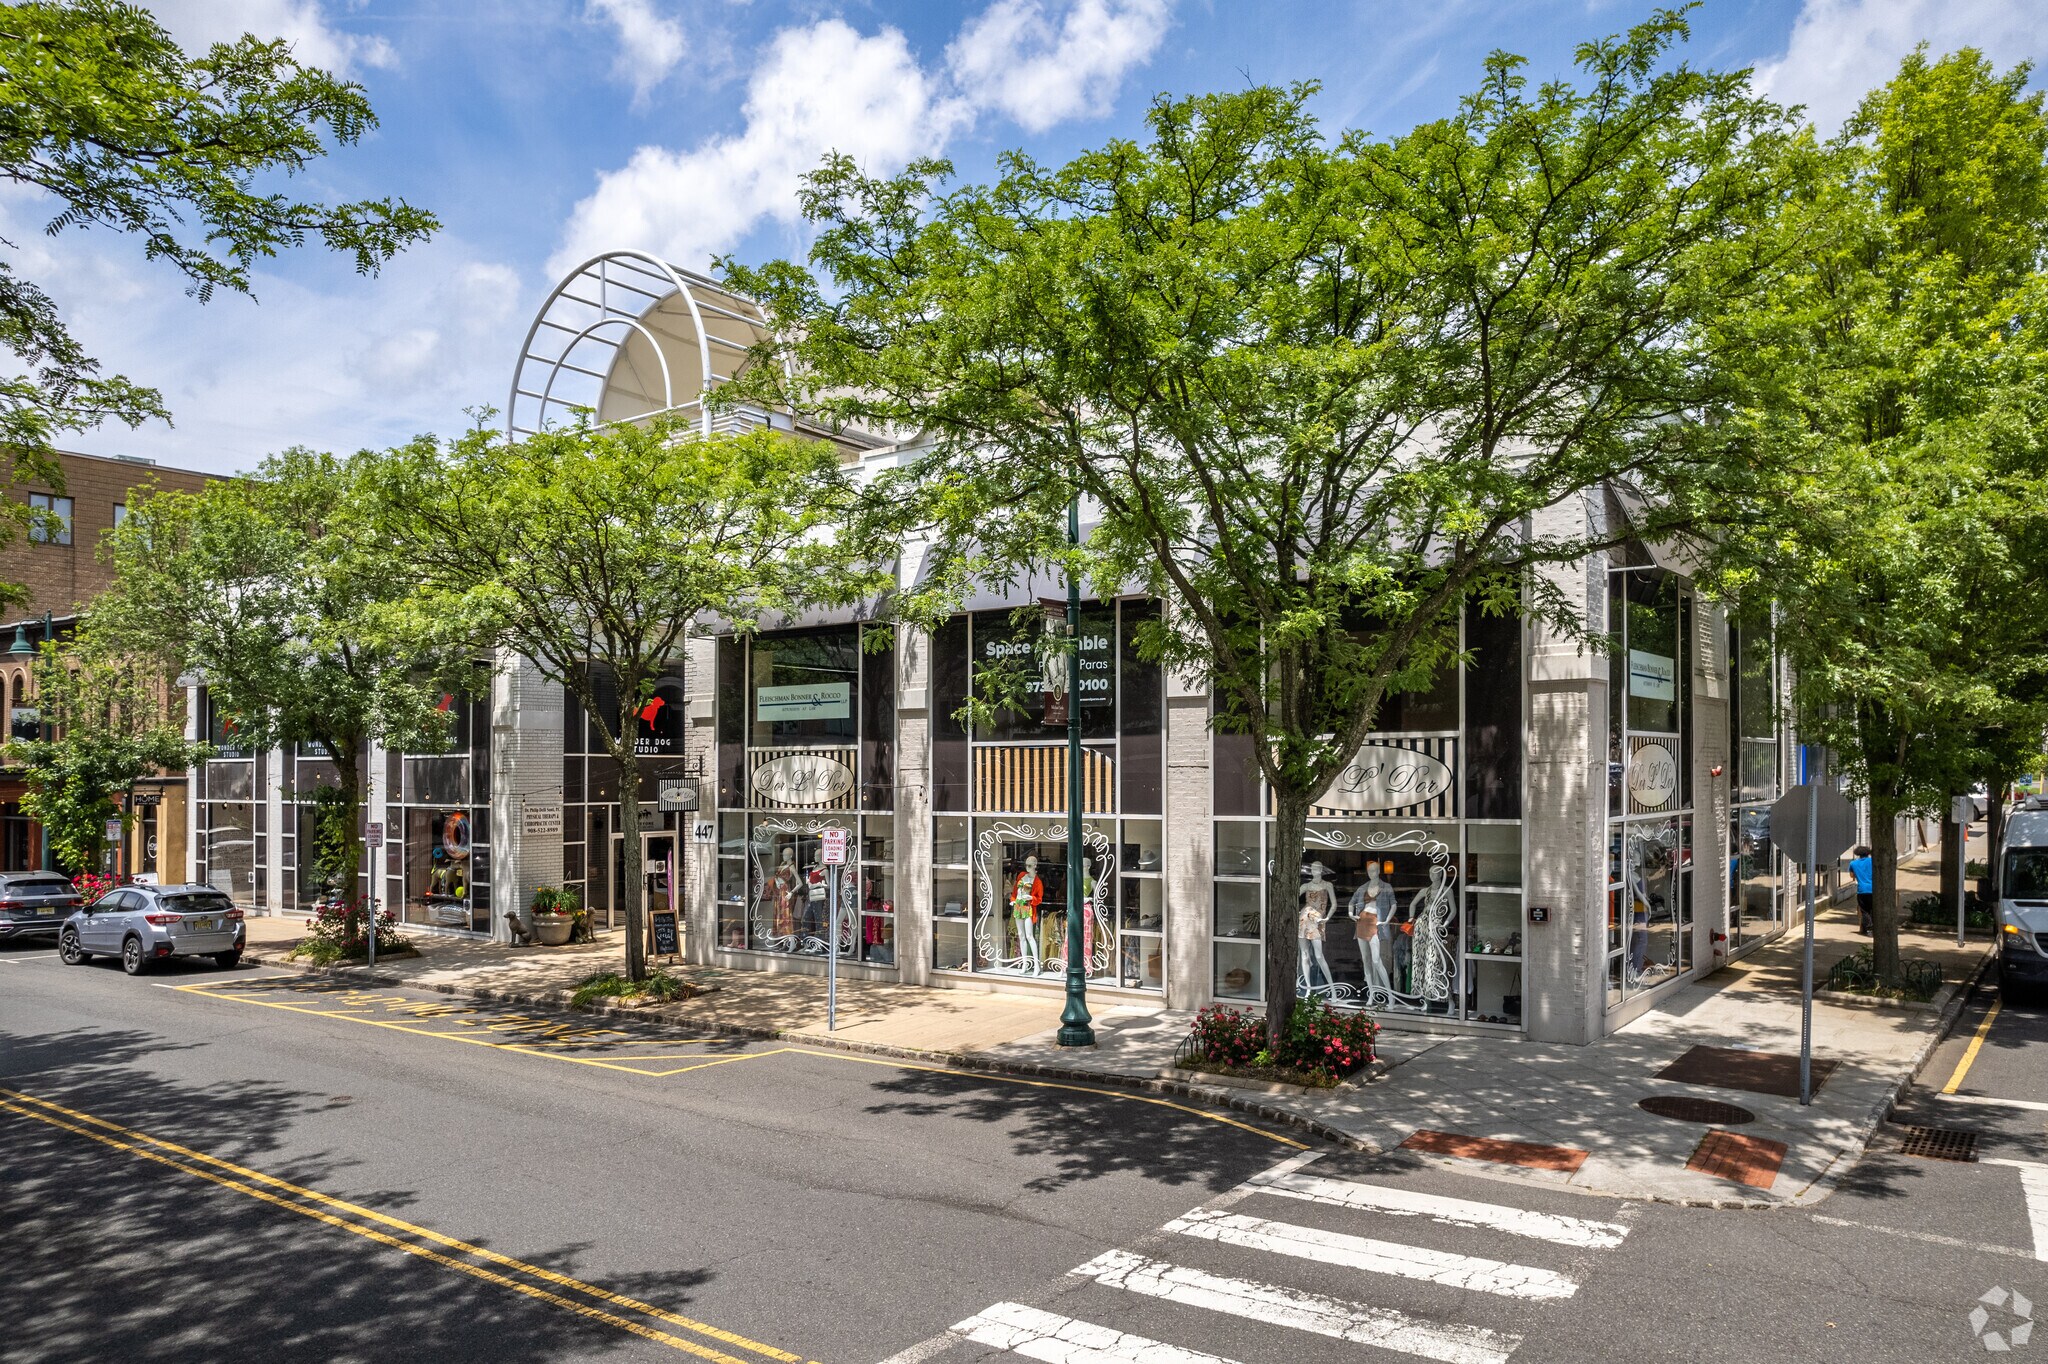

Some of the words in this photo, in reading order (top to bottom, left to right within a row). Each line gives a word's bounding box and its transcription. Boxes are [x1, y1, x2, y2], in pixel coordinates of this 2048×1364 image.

[985, 641, 1031, 659] Space
[1080, 658, 1108, 670] Paras
[759, 694, 790, 702] FLEISCHMAN
[790, 693, 812, 701] BONNER
[812, 693, 822, 706] &
[614, 736, 650, 746] WDER
[654, 738, 671, 746] DOG
[633, 745, 659, 753] TUDIO
[758, 769, 786, 792] Dor
[816, 769, 847, 792] Dor
[1385, 763, 1438, 794] Dor
[695, 824, 714, 839] 447
[453, 1014, 628, 1042] ZONE
